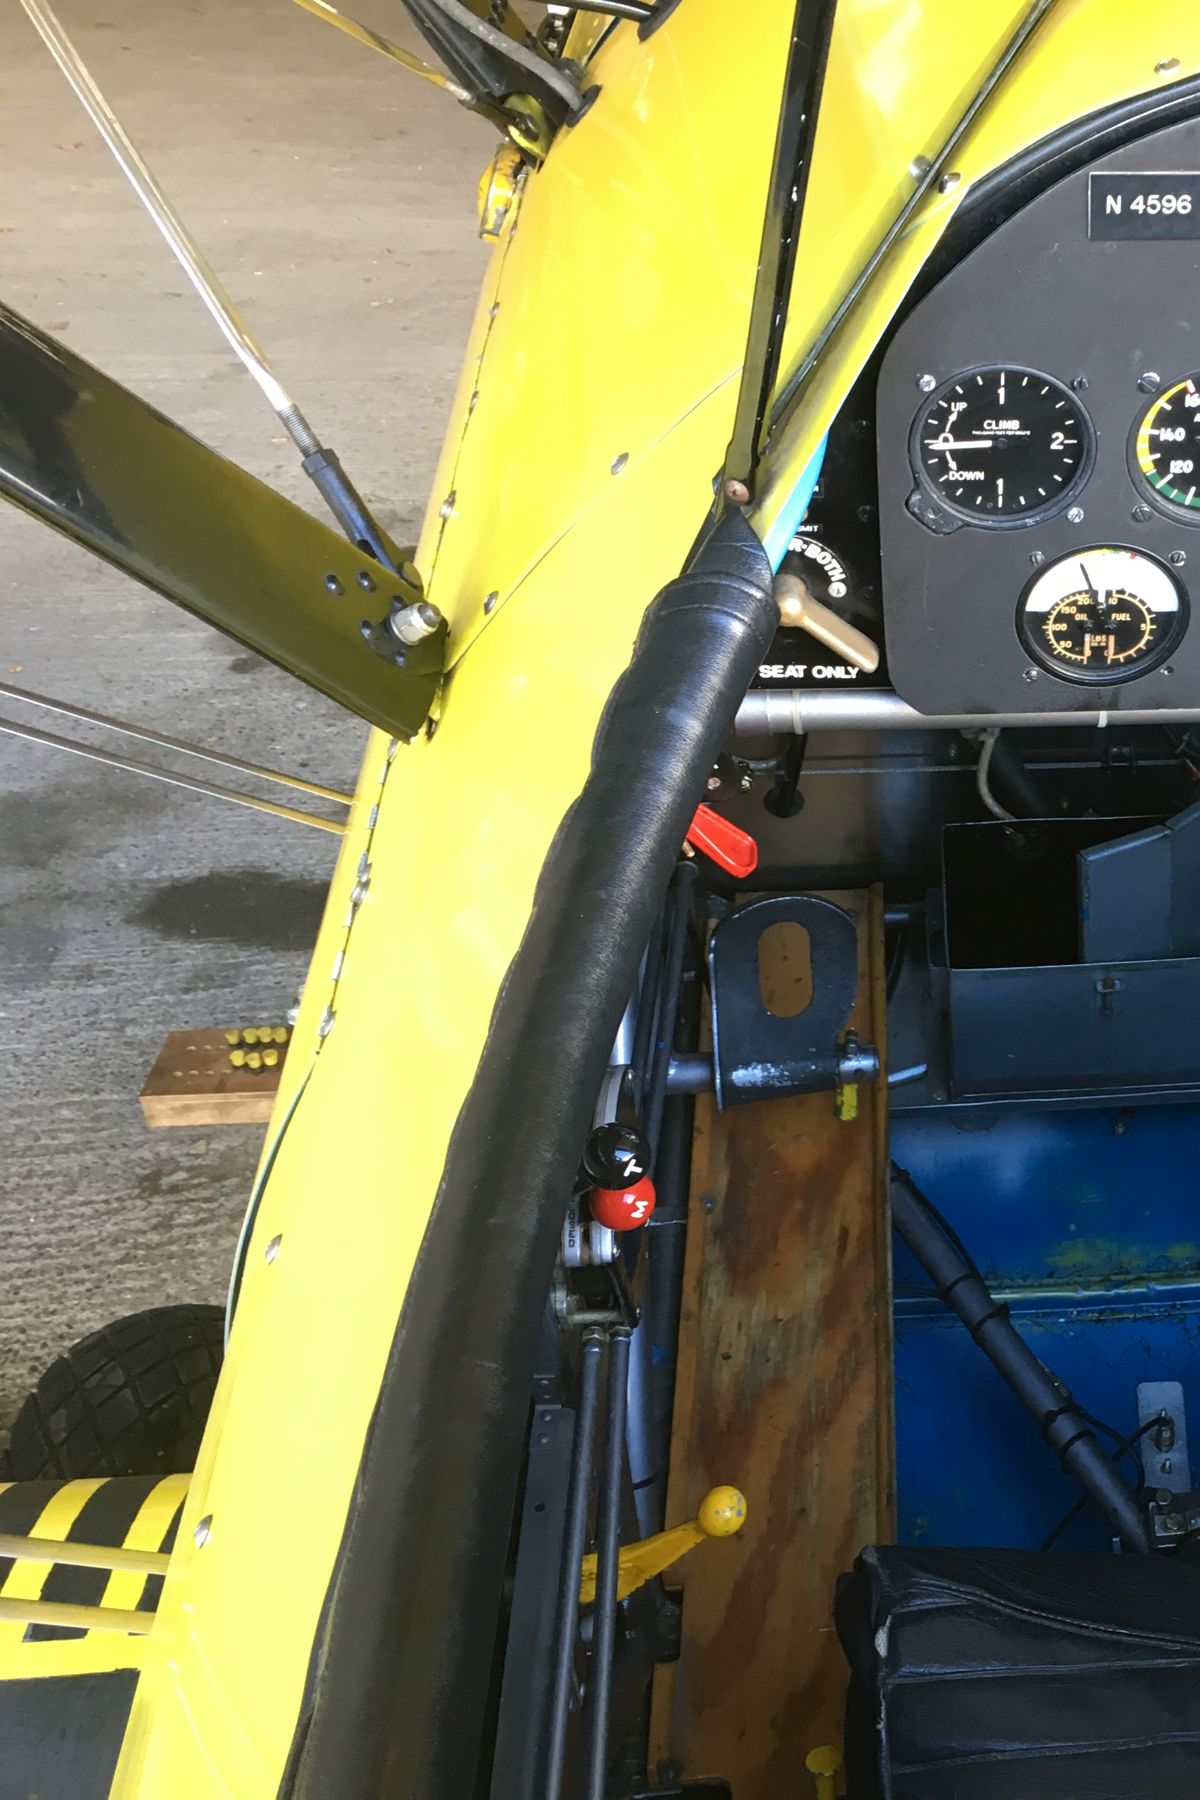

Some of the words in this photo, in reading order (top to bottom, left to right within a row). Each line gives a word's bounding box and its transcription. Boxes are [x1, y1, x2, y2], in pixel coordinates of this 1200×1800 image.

[1105, 194, 1122, 215] N
[1129, 194, 1192, 215] 4596
[997, 386, 1005, 405] 1
[951, 402, 968, 412] UP
[983, 419, 1020, 431] CLIMB
[1049, 432, 1065, 450] 2
[1159, 427, 1186, 442] 140
[1170, 460, 1194, 474] 120
[948, 471, 985, 481] DOWN
[996, 478, 1004, 495] 1
[804, 543, 846, 582] BOTH
[1060, 606, 1077, 614] 150
[1074, 613, 1089, 621] OIL
[1111, 613, 1132, 621] FUEL
[1052, 623, 1068, 631] 100
[1059, 640, 1072, 648] 50
[758, 665, 807, 678] SEAT
[811, 666, 860, 679] ONLY
[623, 1158, 643, 1177] T
[630, 1200, 649, 1218] M
